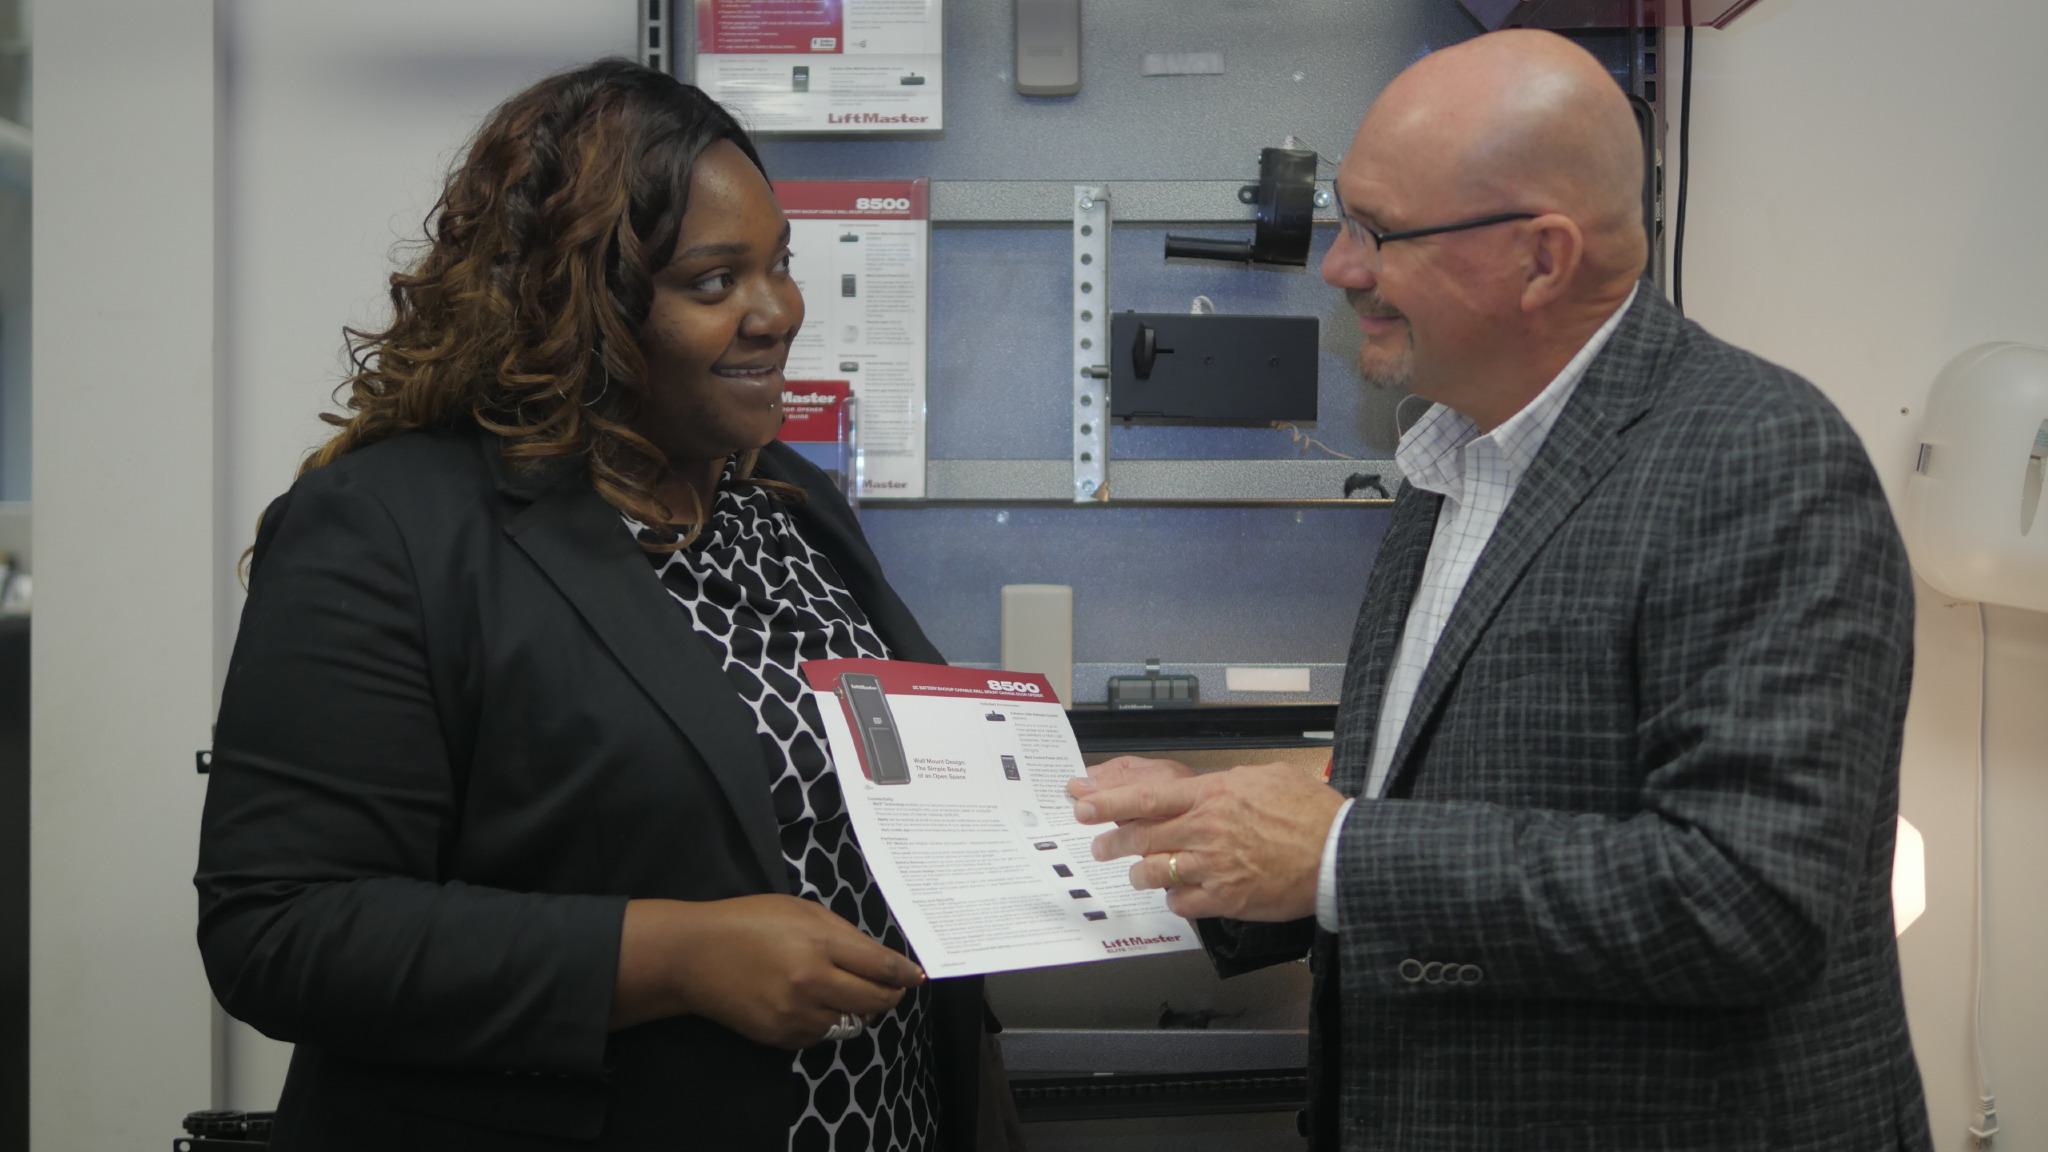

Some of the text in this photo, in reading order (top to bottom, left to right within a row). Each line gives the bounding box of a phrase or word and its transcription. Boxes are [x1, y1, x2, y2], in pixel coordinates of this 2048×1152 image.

[828, 112, 928, 124] LiftMaster
[856, 198, 910, 210] 8500
[986, 679, 1040, 694] 8500
[1102, 934, 1182, 949] LiftMaster
